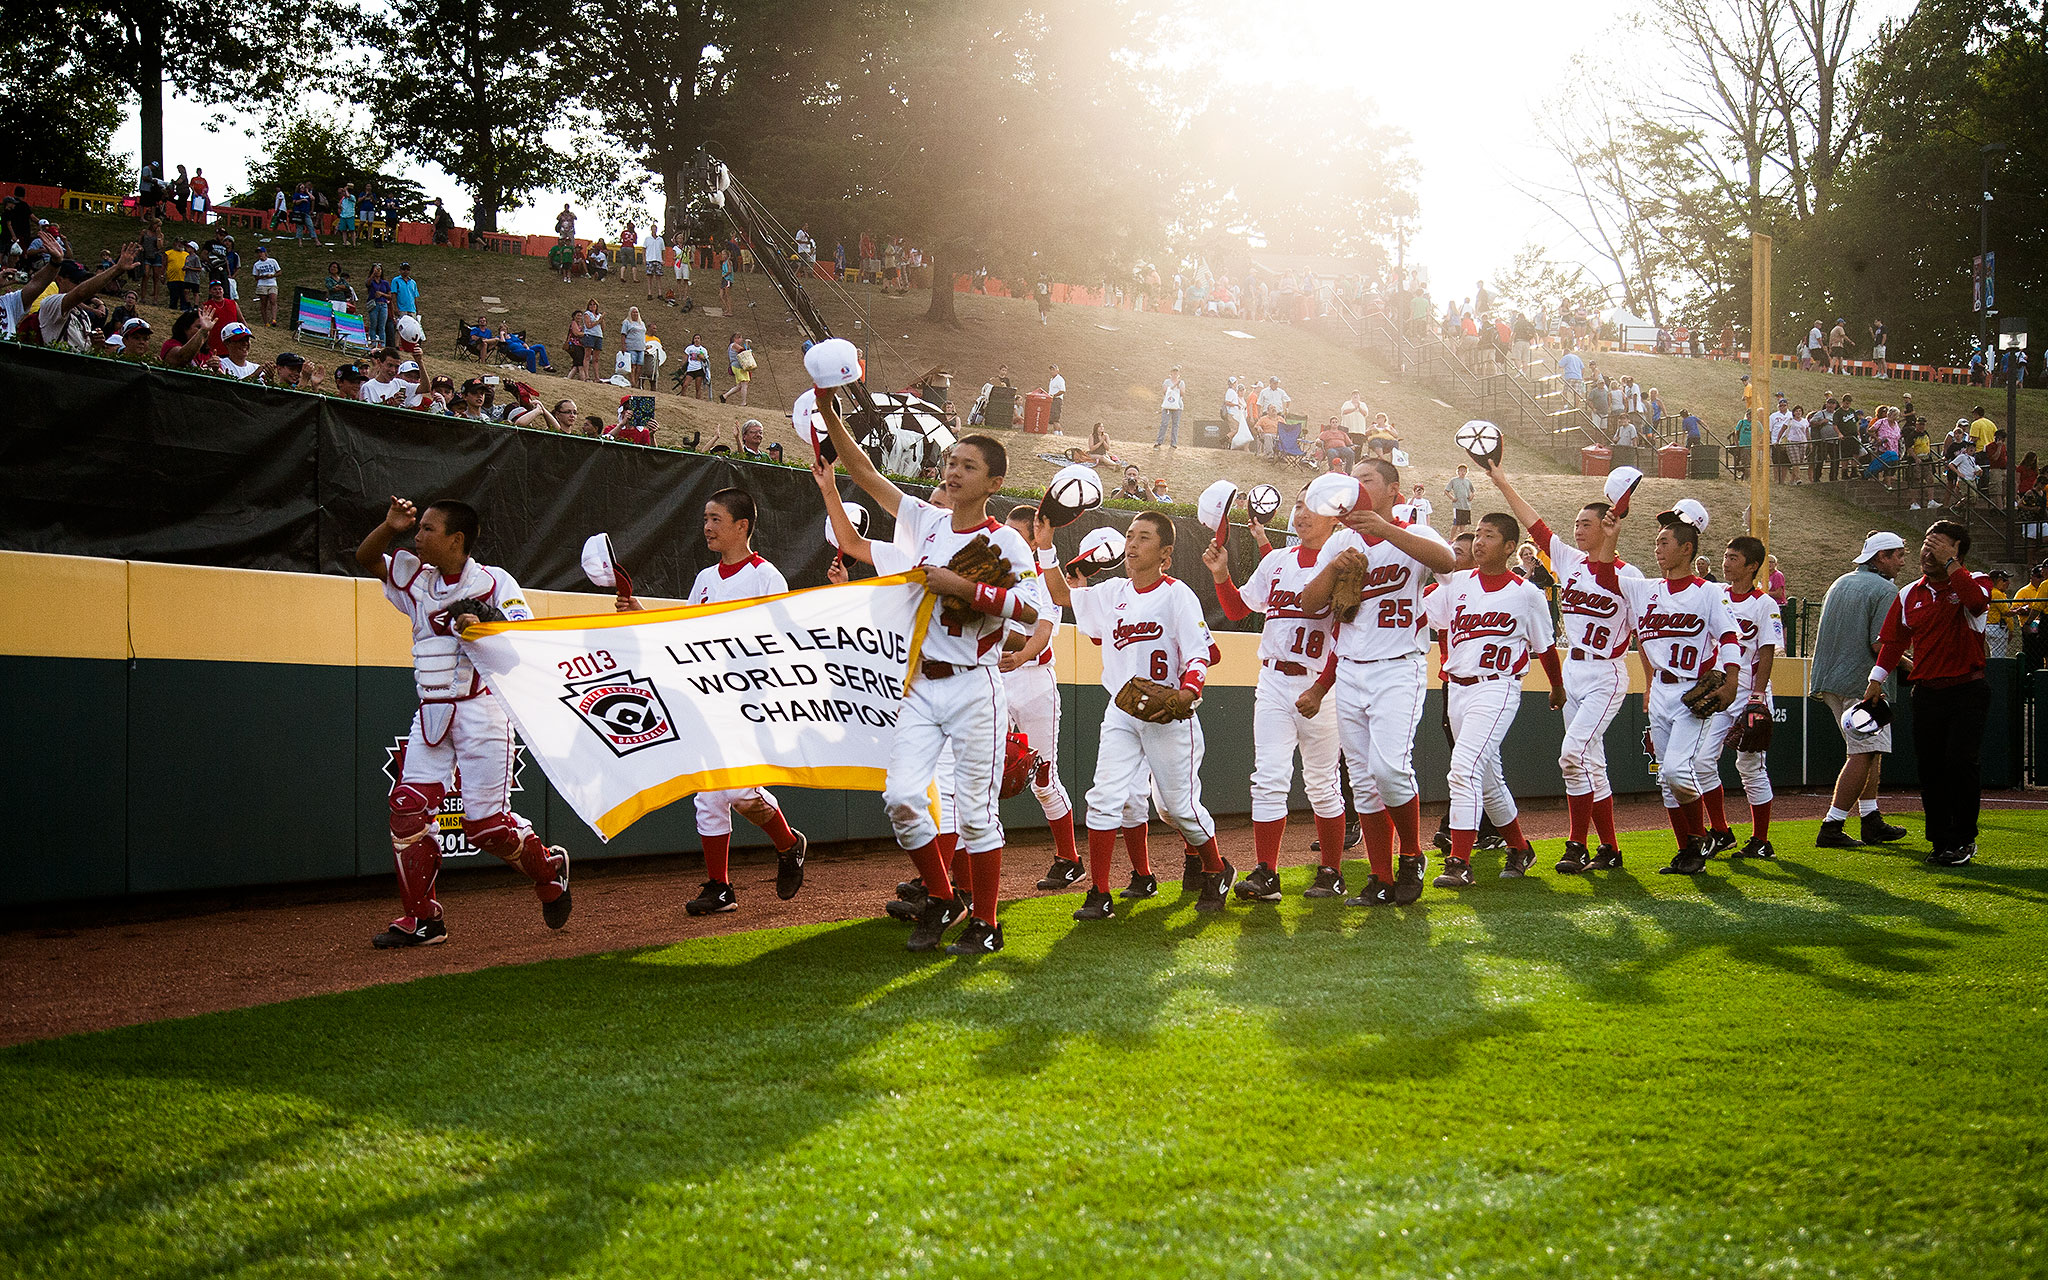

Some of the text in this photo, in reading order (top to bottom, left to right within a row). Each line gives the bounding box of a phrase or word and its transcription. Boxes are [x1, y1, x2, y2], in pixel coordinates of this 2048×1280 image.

[1378, 599, 1413, 629] 25
[1450, 604, 1517, 634] Japan
[1638, 603, 1705, 630] Japan
[1113, 618, 1163, 641] Japan
[1290, 626, 1325, 659] 18
[1581, 622, 1611, 650] 16
[665, 626, 908, 665] LITTLE LEAGUE
[1479, 643, 1512, 671] 20
[1668, 643, 1698, 671] 10
[557, 650, 618, 680] 2013
[1149, 649, 1169, 681] 6
[687, 662, 906, 701] WORLD SERIE
[580, 686, 649, 712] LITTLE LEAGUE
[1772, 708, 1787, 722] 25
[618, 727, 667, 744] BASEBALL
[434, 833, 476, 851] 201
